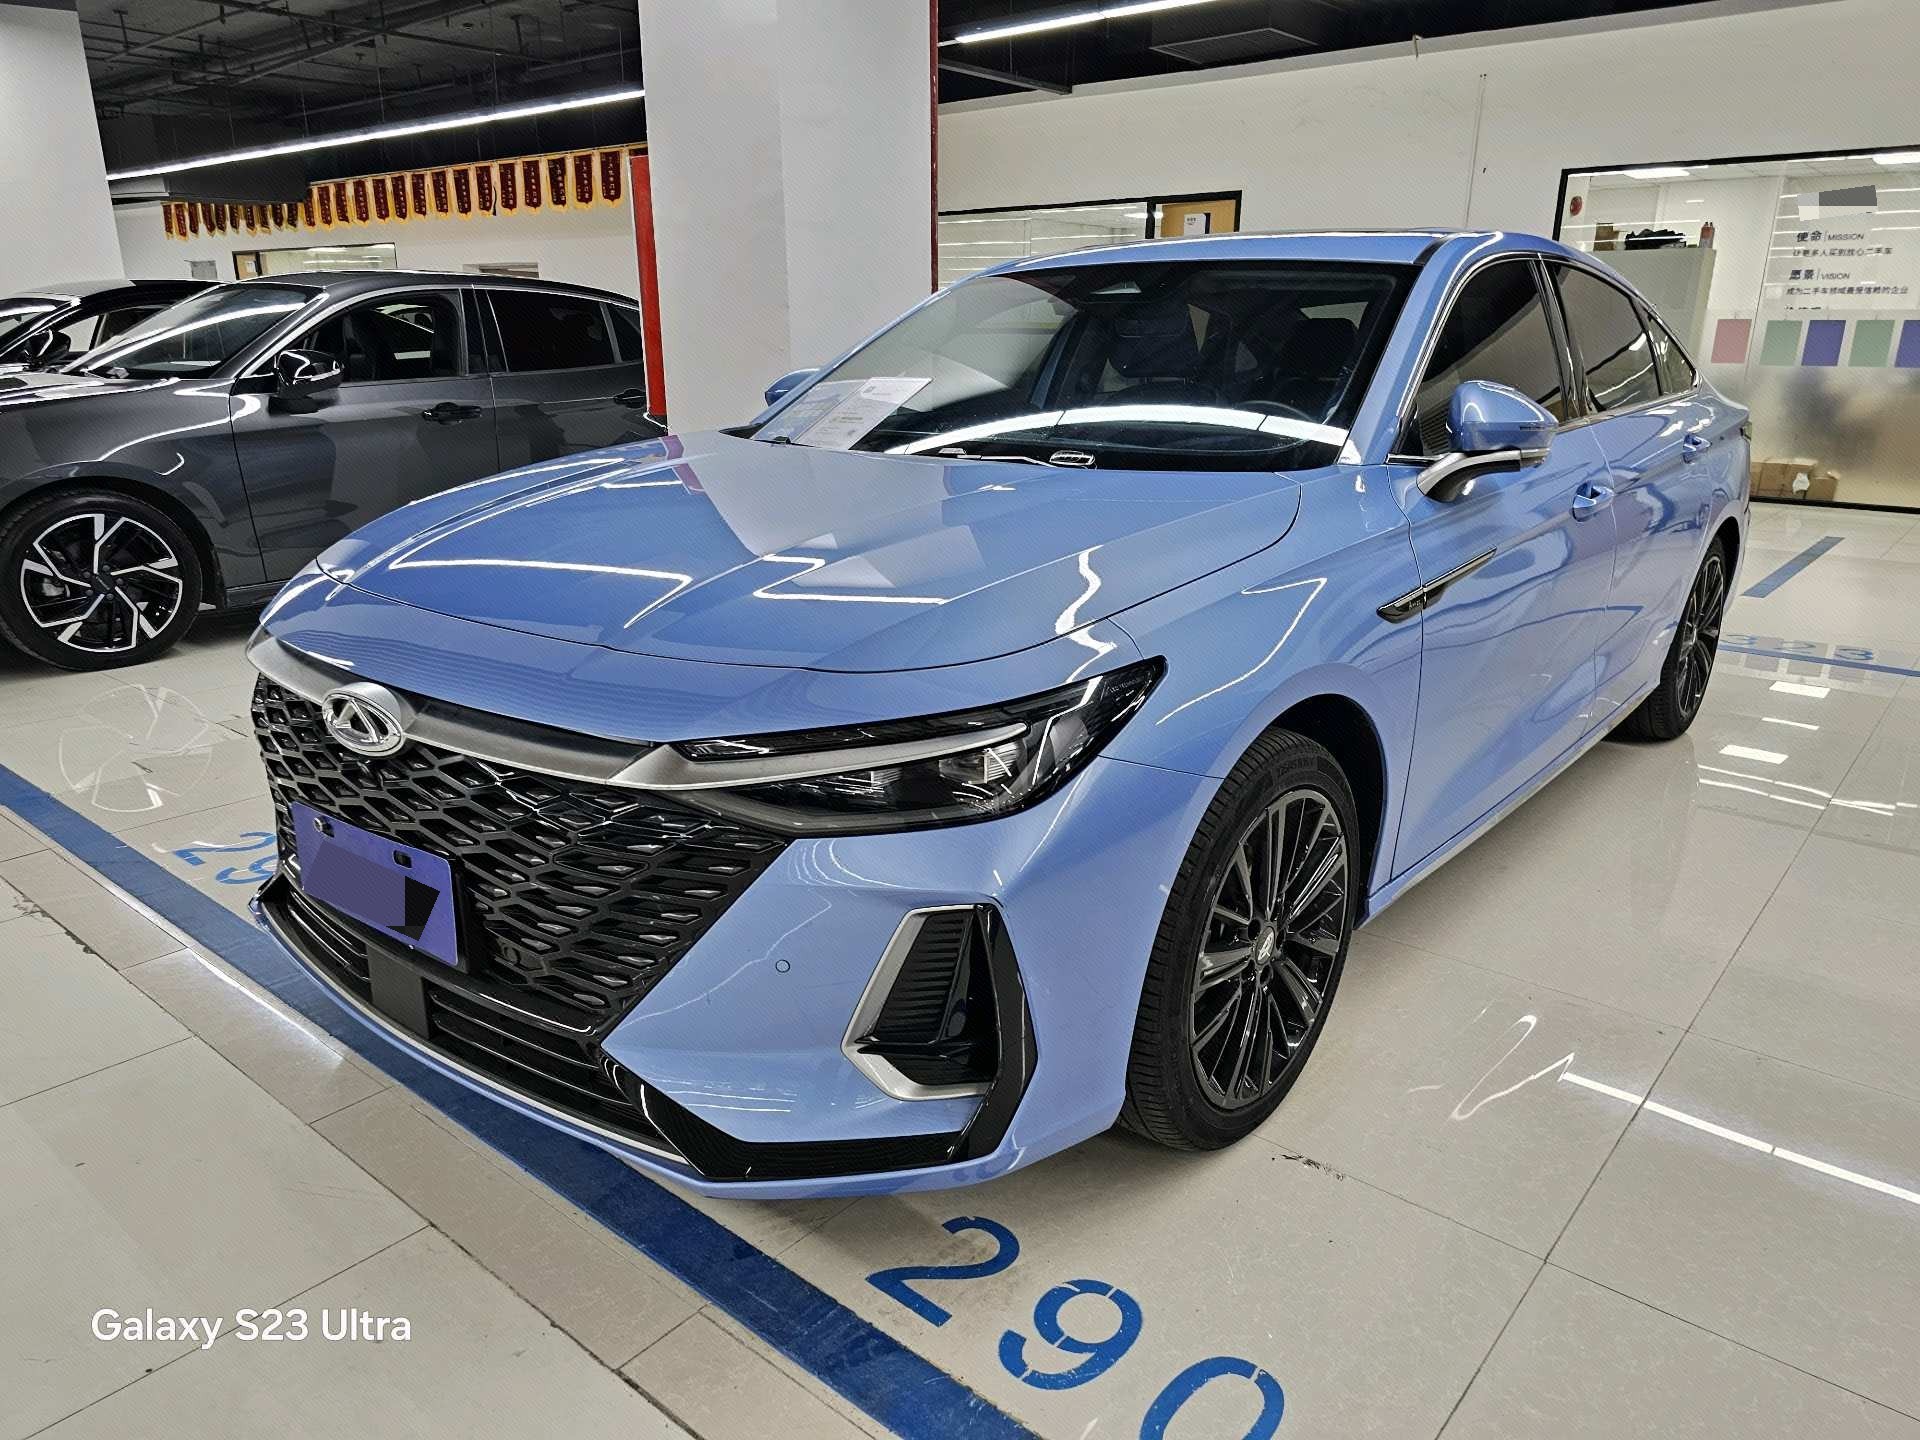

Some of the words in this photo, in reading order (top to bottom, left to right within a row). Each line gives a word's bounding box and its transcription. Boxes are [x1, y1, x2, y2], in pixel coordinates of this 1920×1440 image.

[1796, 230, 1822, 242] 使命
[1828, 233, 1865, 241] MISSION
[1820, 272, 1850, 280] VISION
[865, 1216, 1285, 1440] 290
